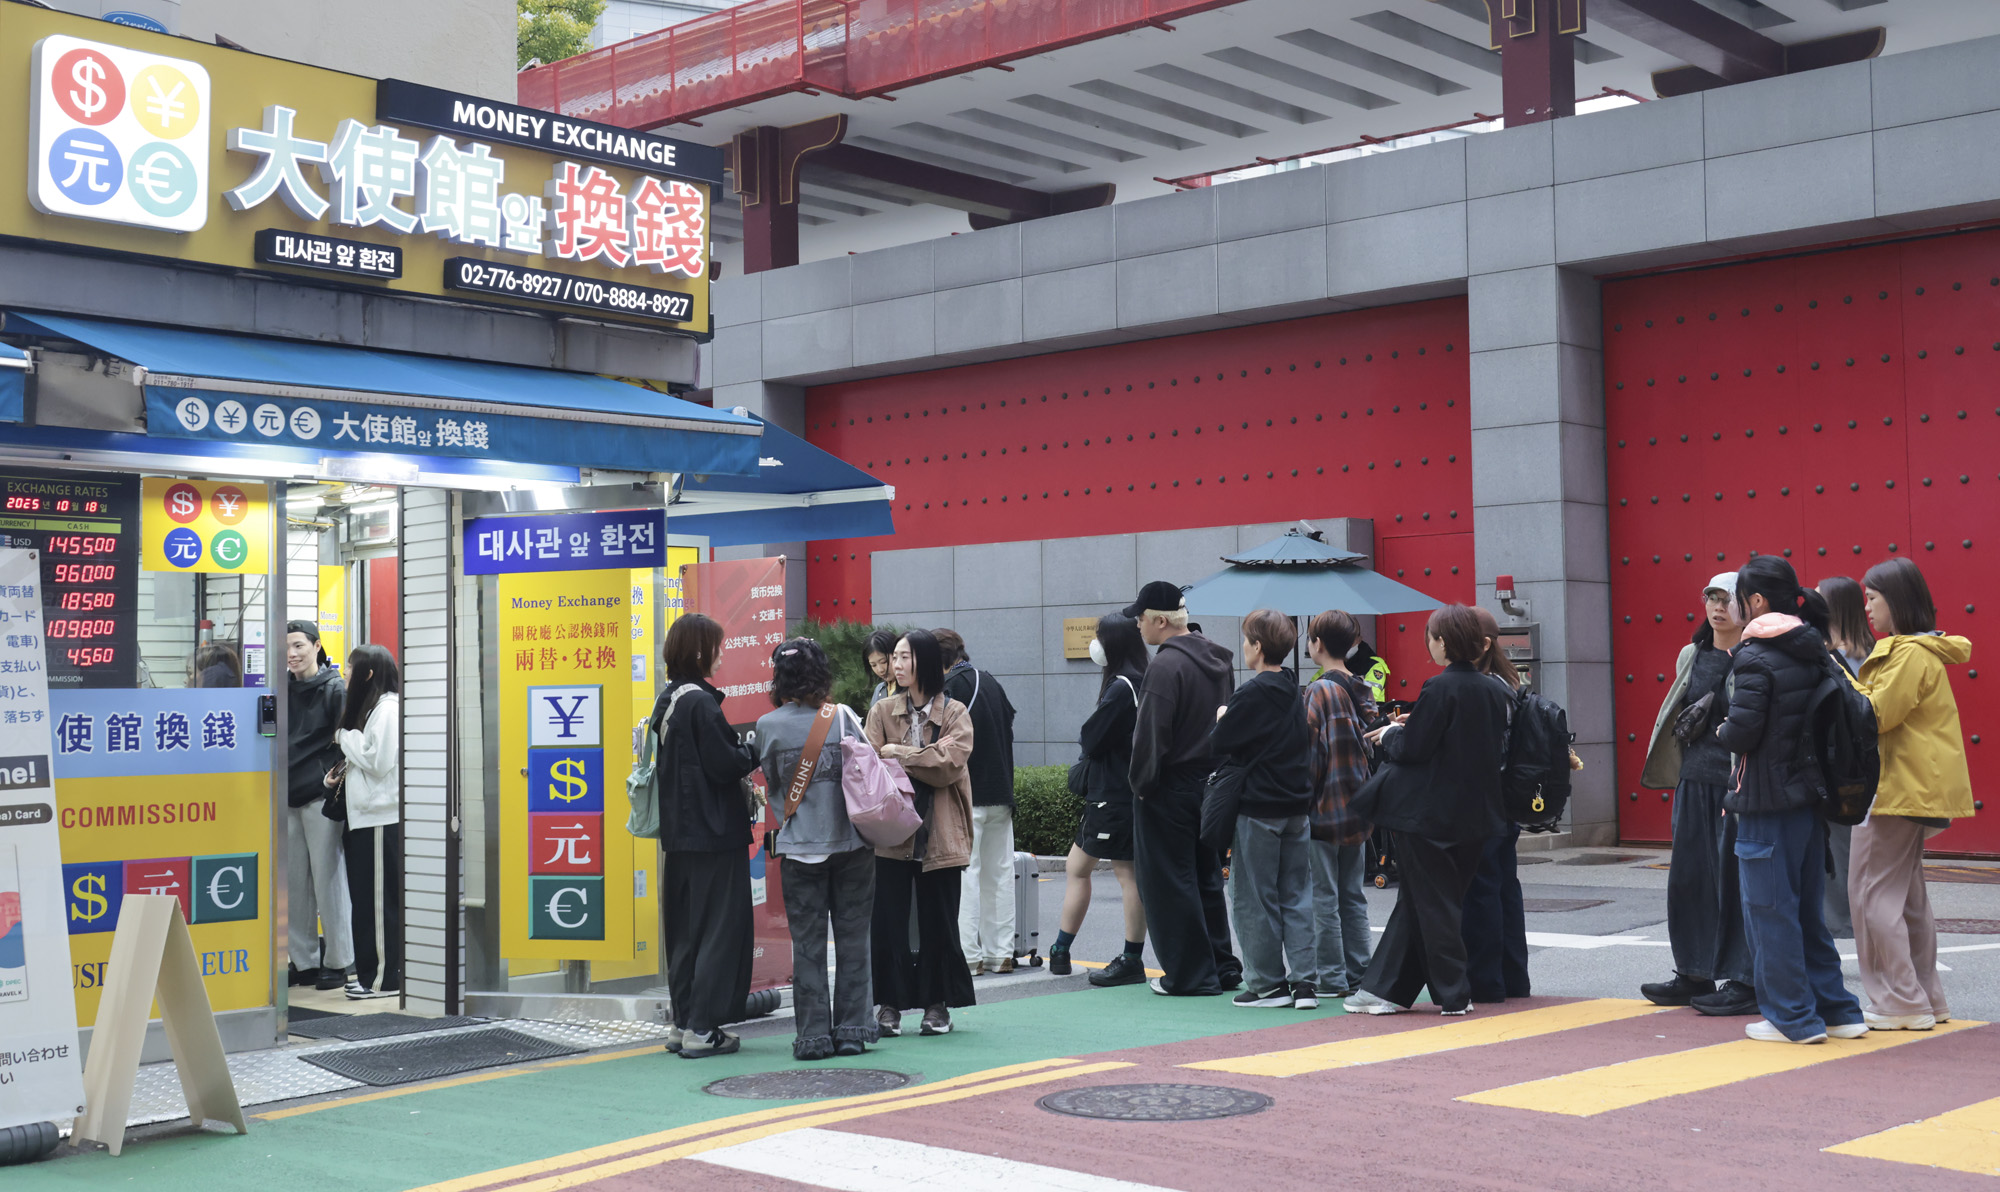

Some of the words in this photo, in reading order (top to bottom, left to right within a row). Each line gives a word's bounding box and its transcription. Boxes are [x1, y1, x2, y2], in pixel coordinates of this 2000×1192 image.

[452, 101, 546, 139] MONEY
[553, 123, 676, 166] EXCHANGE
[61, 139, 111, 193] 元
[275, 235, 332, 264] 대사관
[336, 244, 356, 267] 앞
[359, 247, 395, 273] 환전
[461, 263, 562, 297] 02-776-8927
[574, 281, 689, 317] 070-8884-8927
[260, 411, 279, 430] 元
[7, 482, 71, 496] EXCHANGE
[75, 486, 108, 498] RATES
[6, 497, 40, 510] 2025
[42, 501, 51, 509] 년
[56, 500, 70, 511] 10
[85, 501, 98, 512] 18
[67, 522, 90, 530] CASH
[13, 538, 31, 546] USD
[170, 536, 197, 559] 元
[478, 526, 562, 562] 대사관
[569, 531, 591, 558] 앞
[600, 522, 655, 556] 환전
[512, 597, 553, 610] Money
[558, 595, 621, 608] Exchange
[1, 660, 41, 673] 支払い
[56, 711, 237, 754] 使館換錢
[789, 758, 813, 801] CELINE
[15, 809, 41, 820] Card
[61, 801, 217, 829] COMMISSION
[544, 823, 591, 864] 元
[201, 949, 250, 976] EUR
